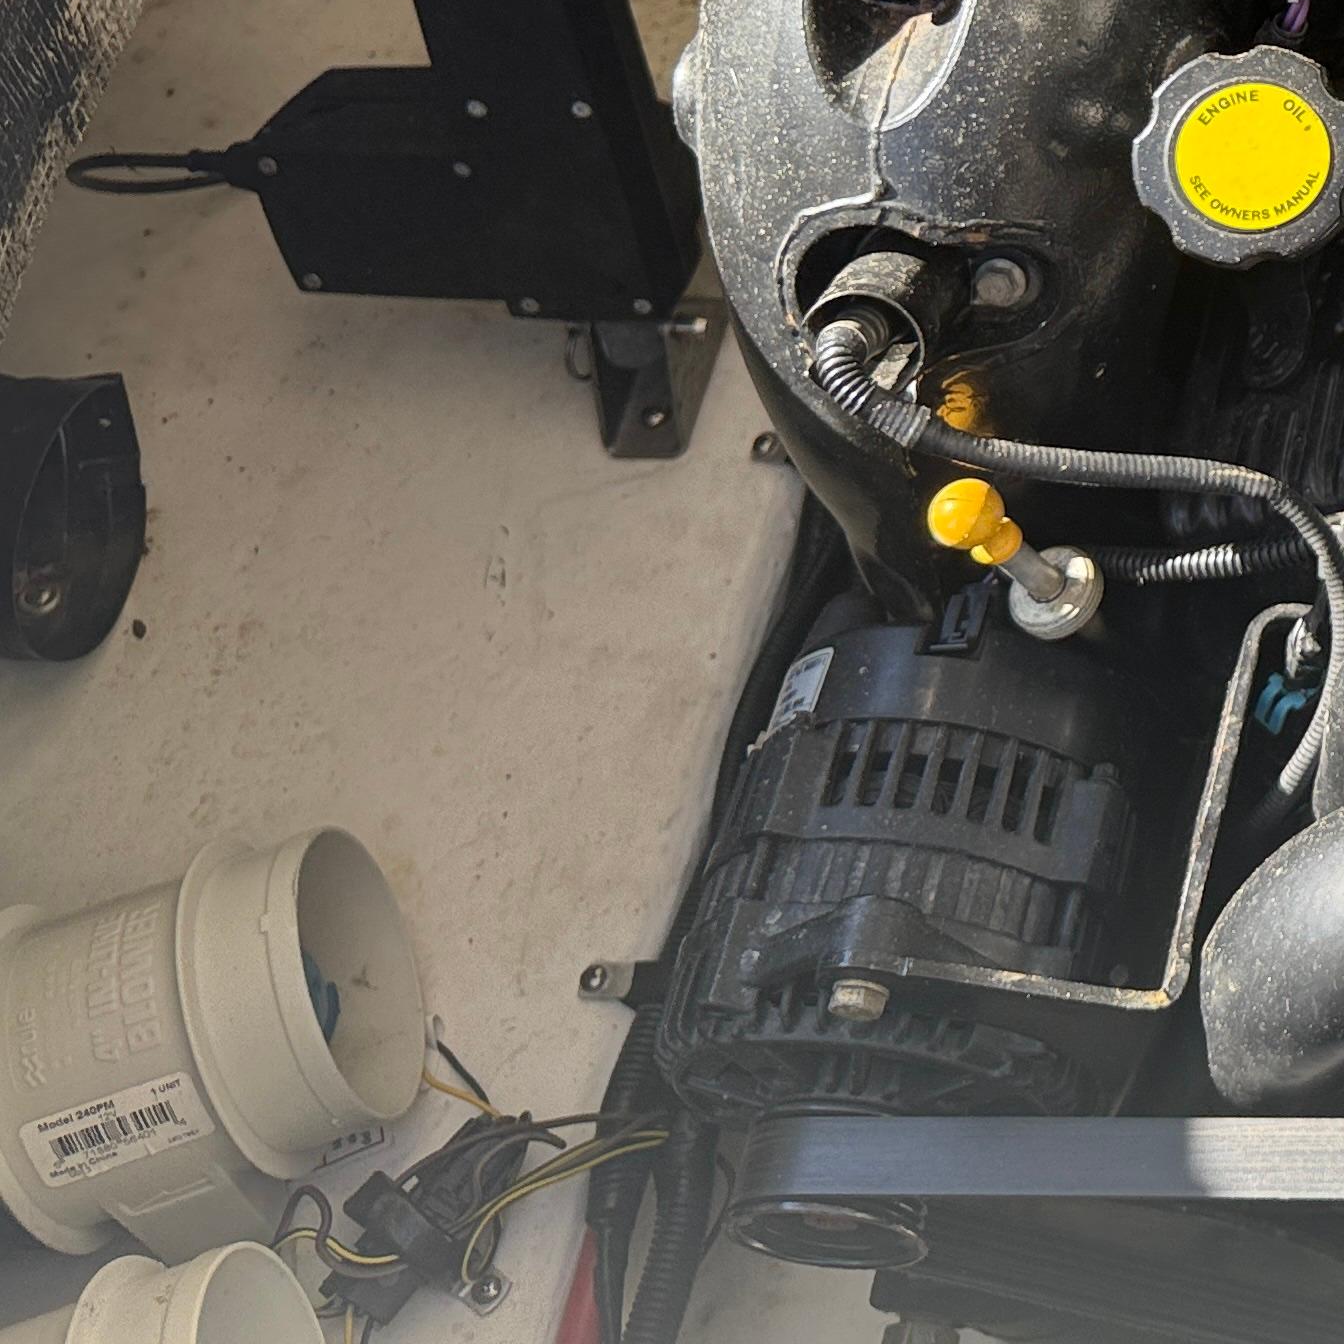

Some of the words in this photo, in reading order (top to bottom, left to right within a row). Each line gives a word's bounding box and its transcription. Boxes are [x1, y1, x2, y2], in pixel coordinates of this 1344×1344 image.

[1196, 89, 1260, 126] ENGINE
[1282, 98, 1306, 123] OIL
[1189, 174, 1212, 201] SEE
[1210, 198, 1271, 222] OWNERS
[1273, 171, 1320, 216] MANUAL
[36, 1112, 73, 1133] Model
